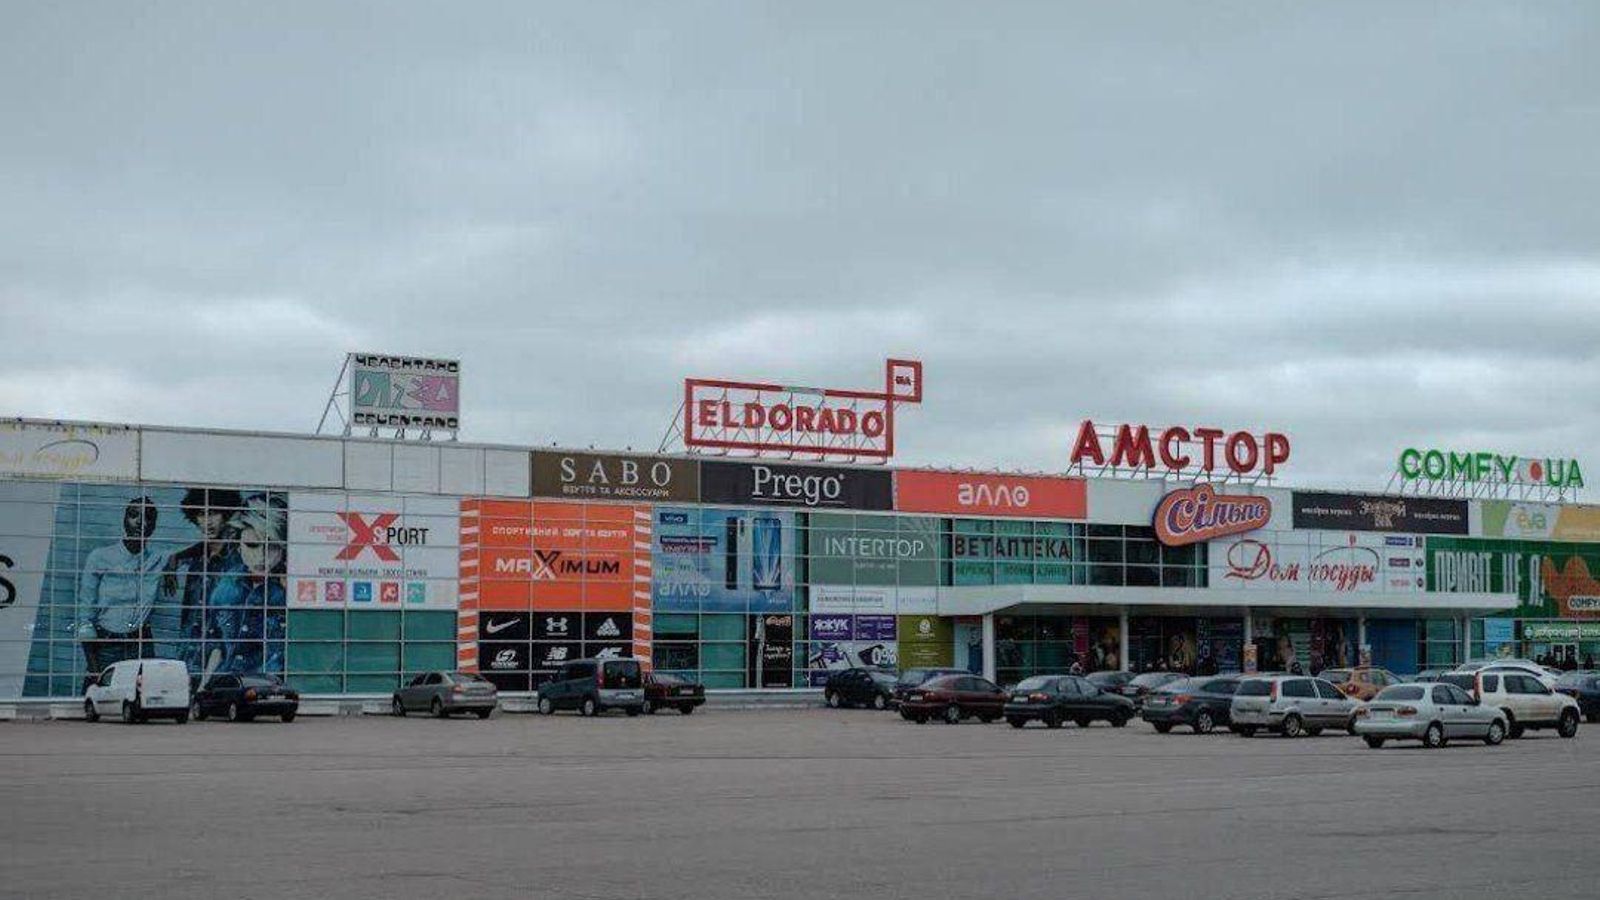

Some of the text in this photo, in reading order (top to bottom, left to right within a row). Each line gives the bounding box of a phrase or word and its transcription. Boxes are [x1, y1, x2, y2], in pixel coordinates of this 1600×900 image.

[699, 399, 884, 438] ELDORADO
[1070, 419, 1291, 475] АМСТОР
[560, 457, 671, 486] SABO
[752, 465, 842, 504] Prego
[1400, 448, 1583, 487] COMFY UA
[825, 537, 924, 557] INTERTOP
[955, 535, 1072, 558] ВЕТАПТЕКА
[1225, 539, 1300, 581] Дом
